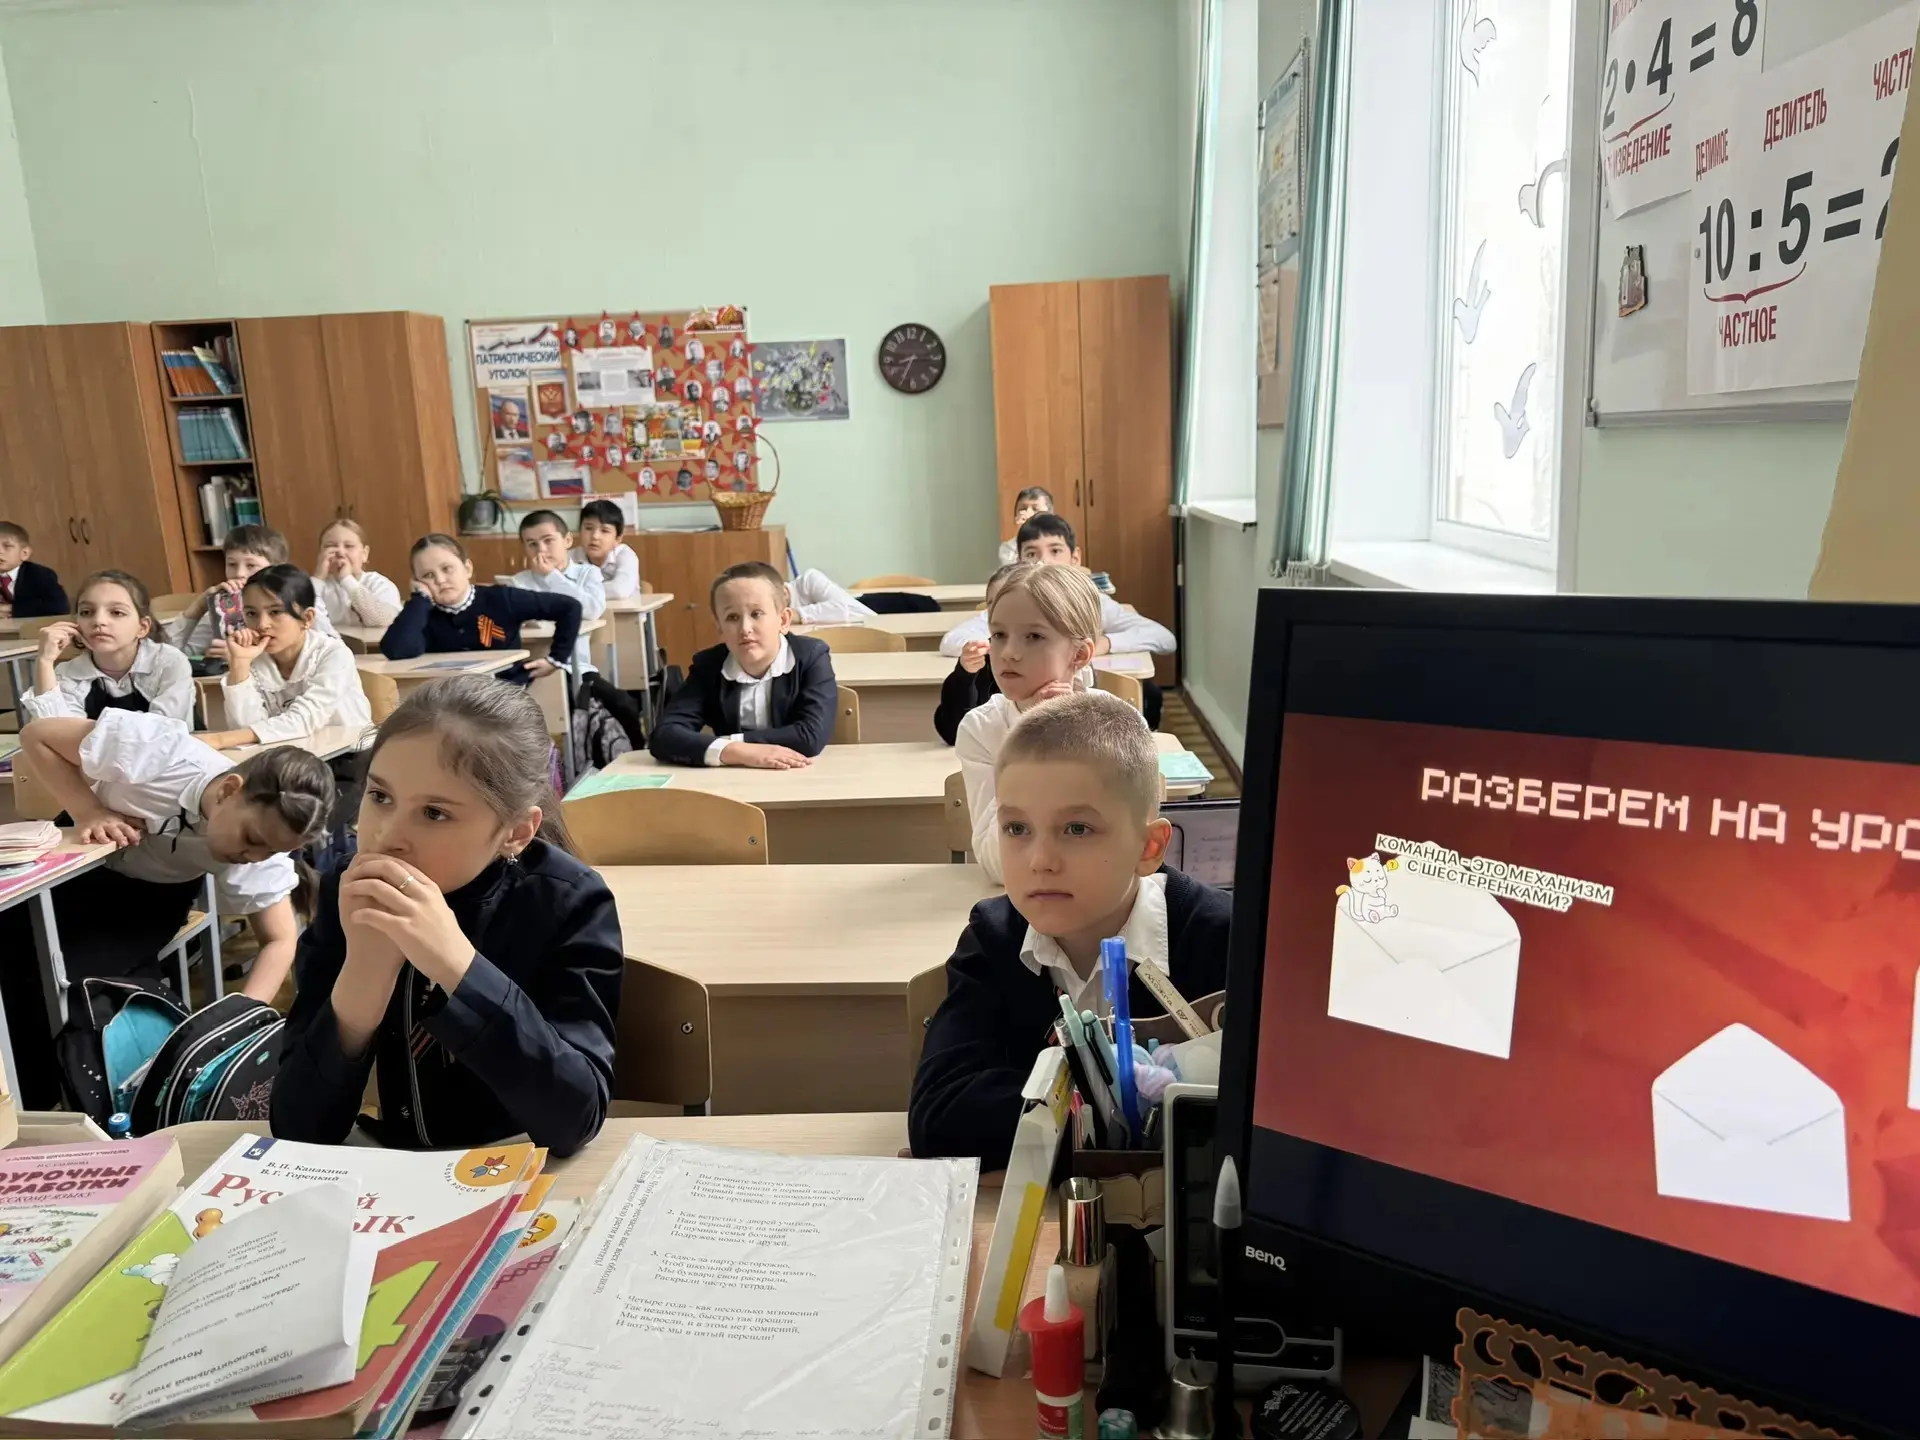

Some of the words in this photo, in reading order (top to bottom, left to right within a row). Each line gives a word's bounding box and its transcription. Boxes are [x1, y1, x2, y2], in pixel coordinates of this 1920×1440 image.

[1647, 18, 1672, 95] 4
[1763, 88, 1827, 152] ДЕЛИТЕЛЬ
[1604, 124, 1672, 187] ИЗВЕДЕНИЕ
[1696, 129, 1728, 182] ДЕЛИМОЕ
[1700, 199, 1735, 285] 10
[1778, 171, 1813, 265] 5
[907, 328, 916, 339] 12
[1719, 306, 1777, 348] ЧАСТНОЕ
[477, 349, 560, 365] ПАТРИОТИЧЕСКИЙ
[489, 369, 528, 380] УГОЛОК
[1421, 767, 1689, 831] РАЗБЕРЕМ
[1710, 798, 1786, 844] НА
[1378, 836, 1459, 866] КОМАНДА
[1472, 859, 1506, 876] ЭТО
[1509, 868, 1611, 903] МЕХАНИЗМ
[1408, 860, 1419, 872] С
[1421, 863, 1570, 910] ШЕСТЕРЕНКАМИ?
[285, 1172, 339, 1181] Горецкий
[295, 1165, 348, 1174] Канакина
[1245, 1245, 1286, 1271] BenQ
[654, 1273, 700, 1285] Раскрыли
[624, 1302, 642, 1311] Так
[628, 1294, 663, 1307] Четыре
[714, 1306, 763, 1315] несколько
